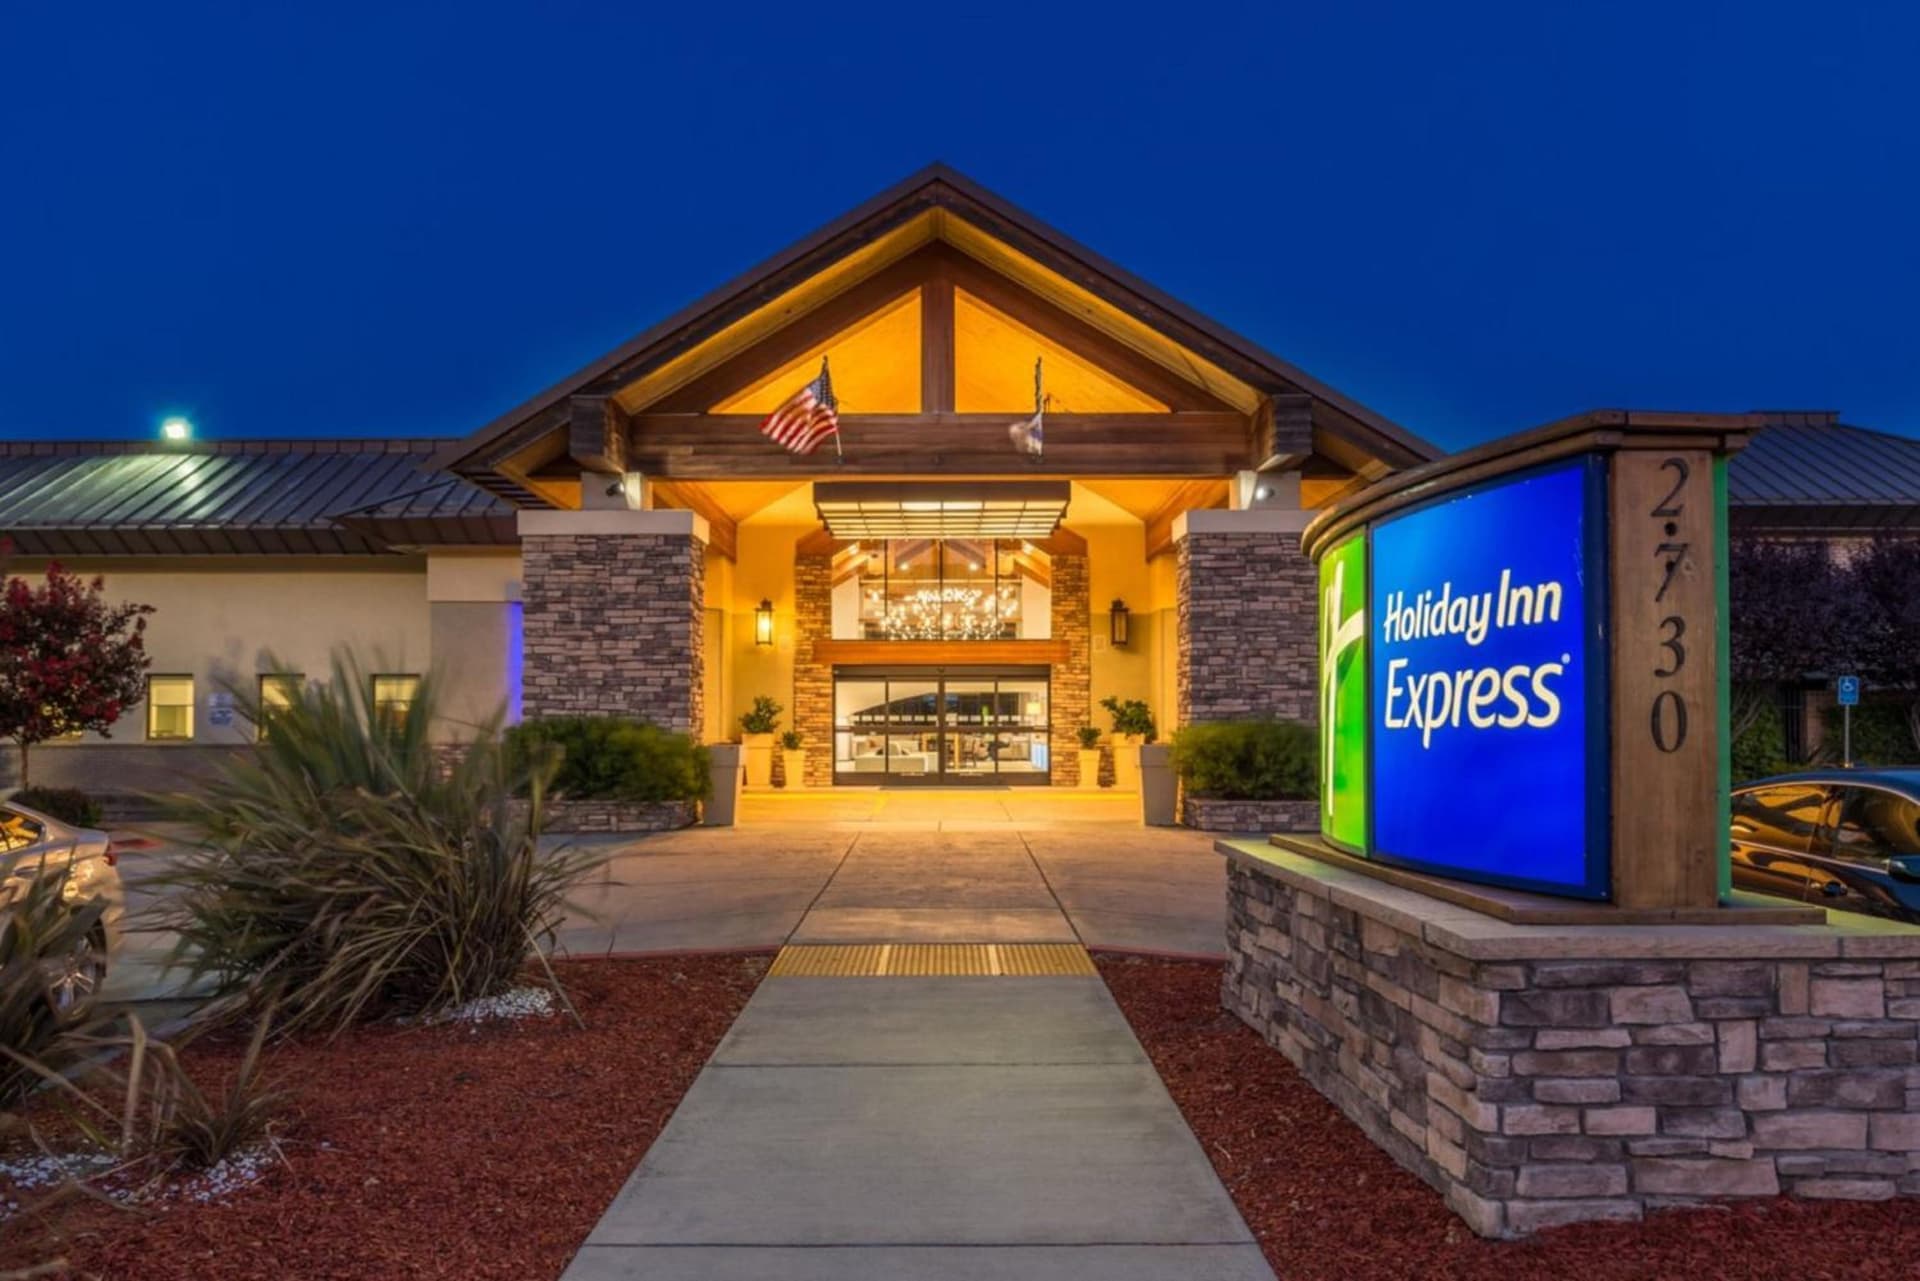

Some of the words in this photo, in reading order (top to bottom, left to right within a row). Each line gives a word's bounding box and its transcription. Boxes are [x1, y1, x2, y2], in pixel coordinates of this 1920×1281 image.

[1384, 581, 1492, 645] Holiday
[1496, 568, 1562, 628] Inn
[1651, 457, 1690, 754] 2730
[1385, 658, 1563, 749] Express
